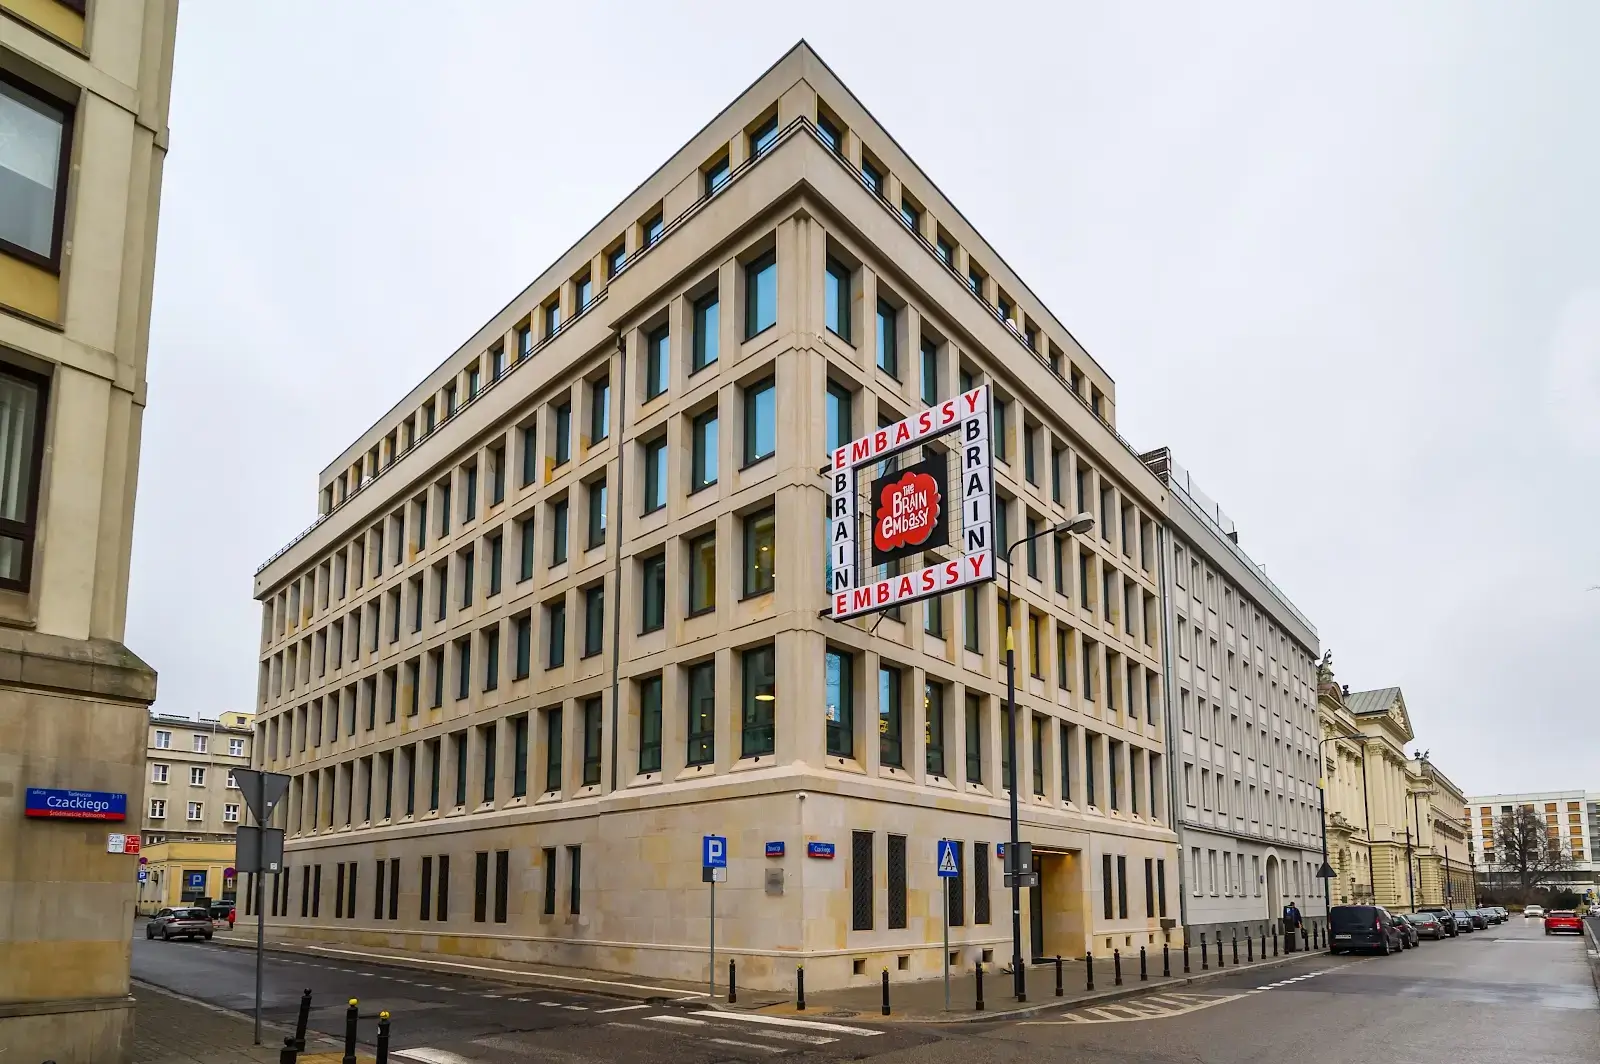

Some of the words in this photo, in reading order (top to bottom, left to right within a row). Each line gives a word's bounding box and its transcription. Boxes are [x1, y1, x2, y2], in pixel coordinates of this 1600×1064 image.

[835, 389, 981, 470] EMBASSY
[892, 489, 928, 519] BRAIN
[966, 418, 985, 551] BRAIN
[834, 472, 849, 591] BRAIN
[836, 553, 985, 615] EMBASSY
[46, 796, 109, 812] Czackiego
[708, 840, 722, 863] P
[193, 875, 202, 885] P
